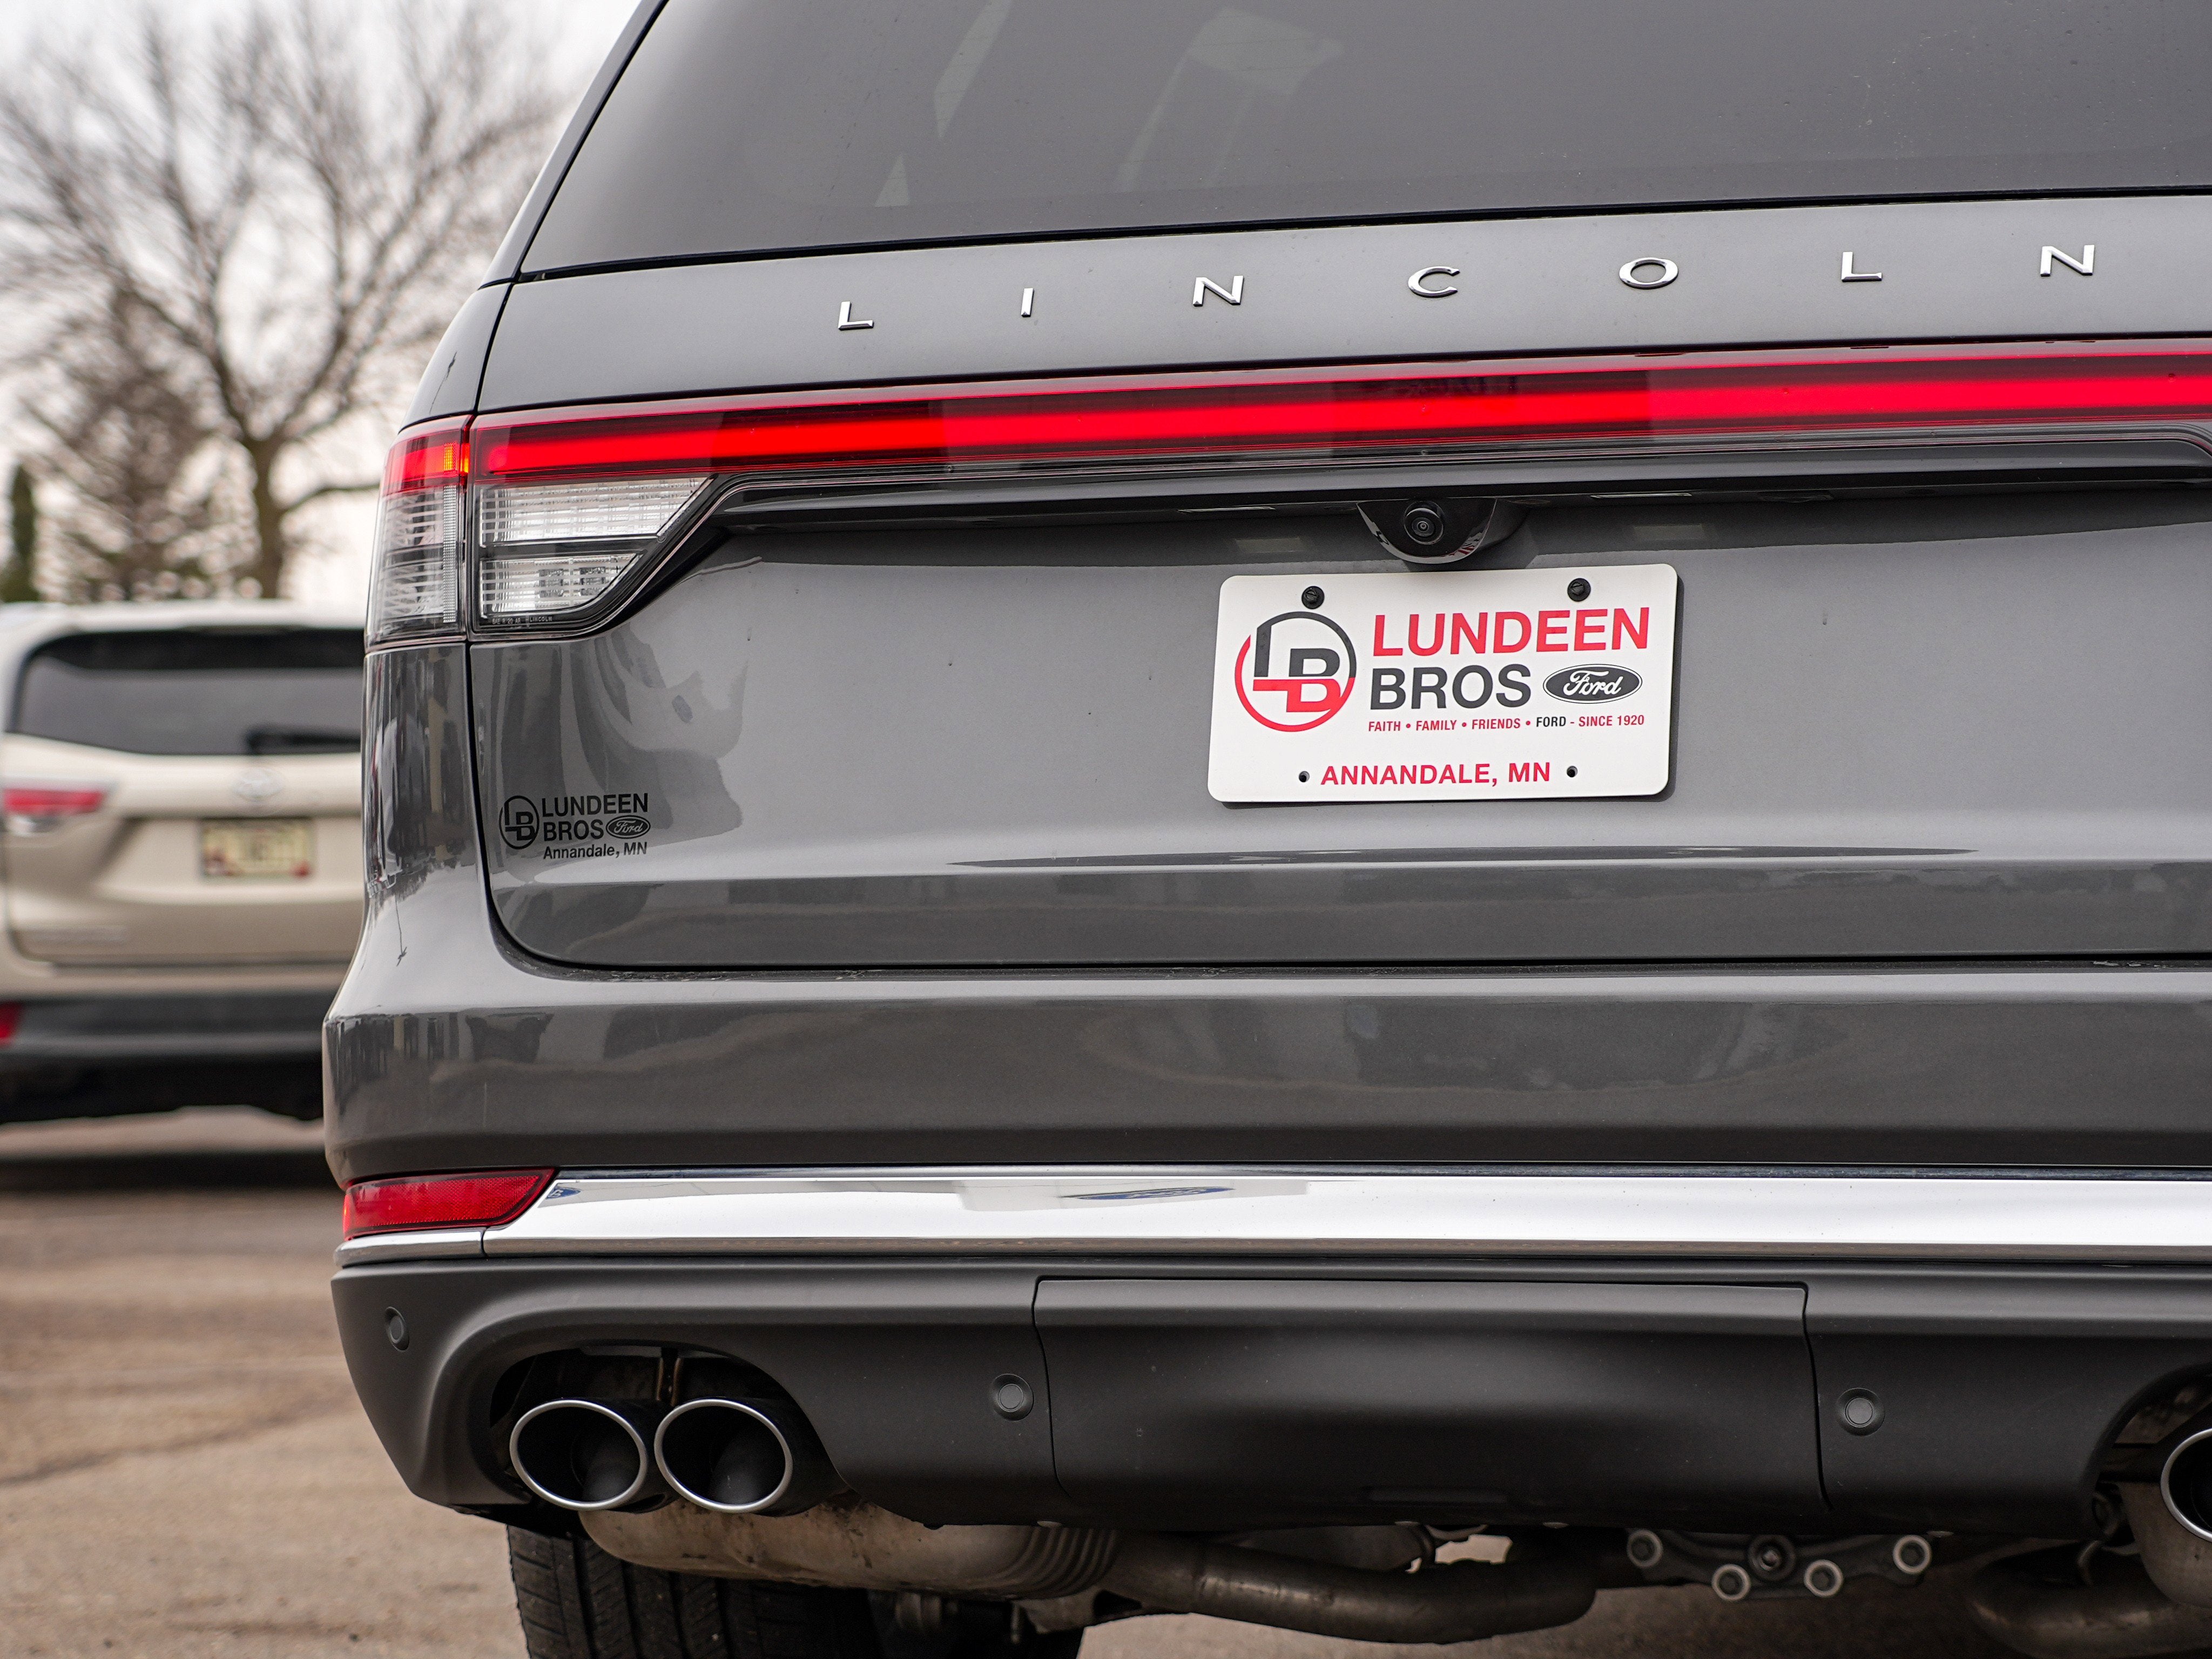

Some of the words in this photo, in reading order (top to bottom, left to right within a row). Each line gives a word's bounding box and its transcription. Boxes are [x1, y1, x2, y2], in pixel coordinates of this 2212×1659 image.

[838, 244, 2095, 331] LINCOLN
[1373, 607, 1650, 656] LUNDEEN
[1370, 664, 1532, 710] BROS
[1368, 721, 1401, 732] FAITH
[1415, 719, 1457, 731] FAMILY
[1471, 718, 1521, 730] FRIENDS
[1536, 716, 1567, 727] FORD
[1579, 716, 1613, 727] SINCE
[1617, 714, 1645, 726] 1920
[1320, 763, 1497, 787] ANNANDALE,
[1508, 762, 1550, 782] MN
[542, 793, 648, 817] LUNDEEN
[543, 819, 604, 841] BROS
[543, 844, 620, 860] Annandale,
[623, 842, 648, 855] MN
